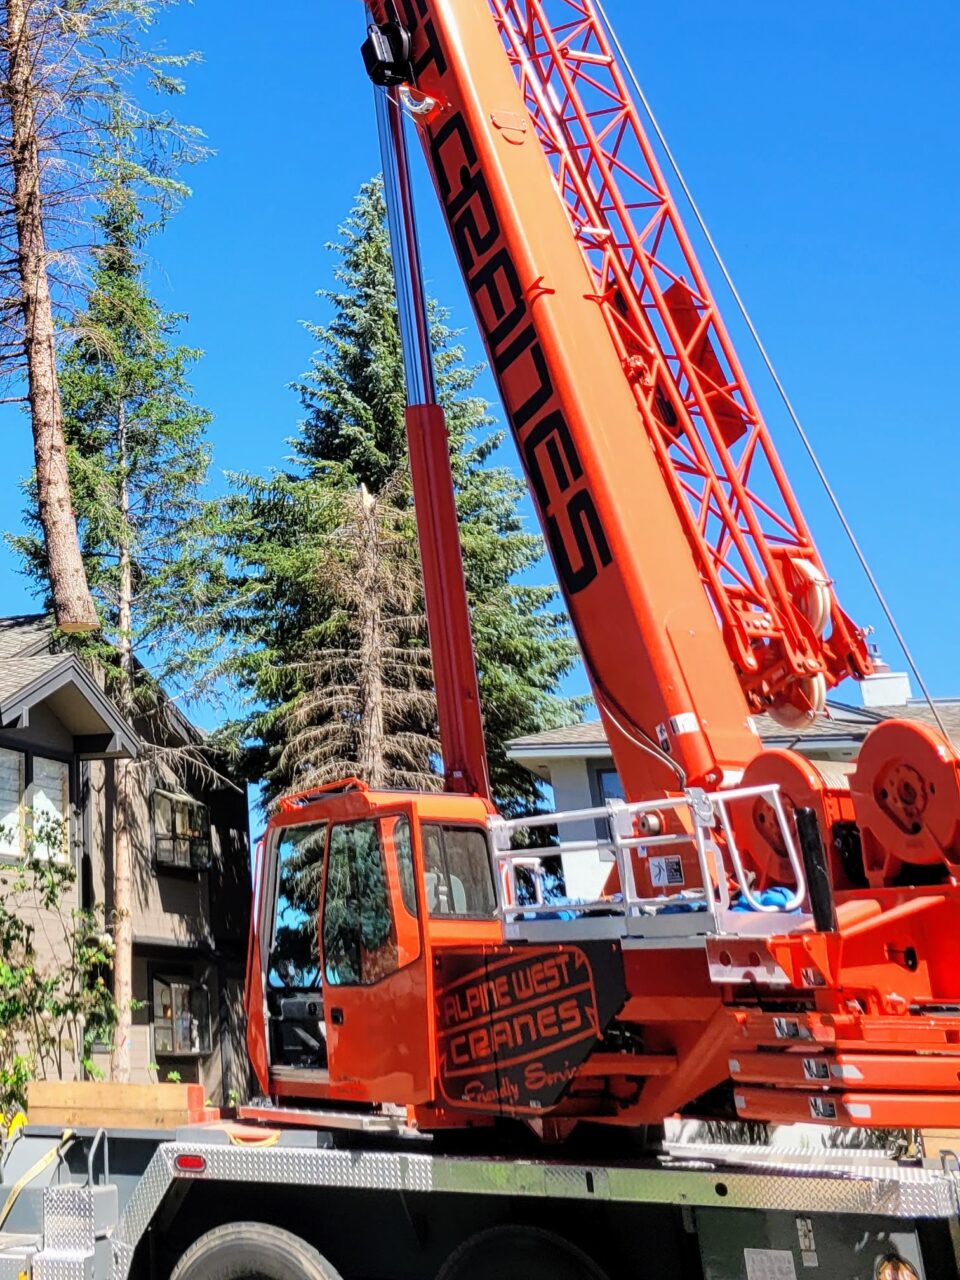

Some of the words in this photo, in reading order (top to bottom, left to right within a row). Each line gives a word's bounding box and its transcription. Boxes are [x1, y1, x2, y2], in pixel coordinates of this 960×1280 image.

[433, 111, 613, 595] CRANES
[443, 975, 511, 1025] ALPINE
[511, 954, 570, 1000] WEST
[449, 998, 582, 1065] CRANES
